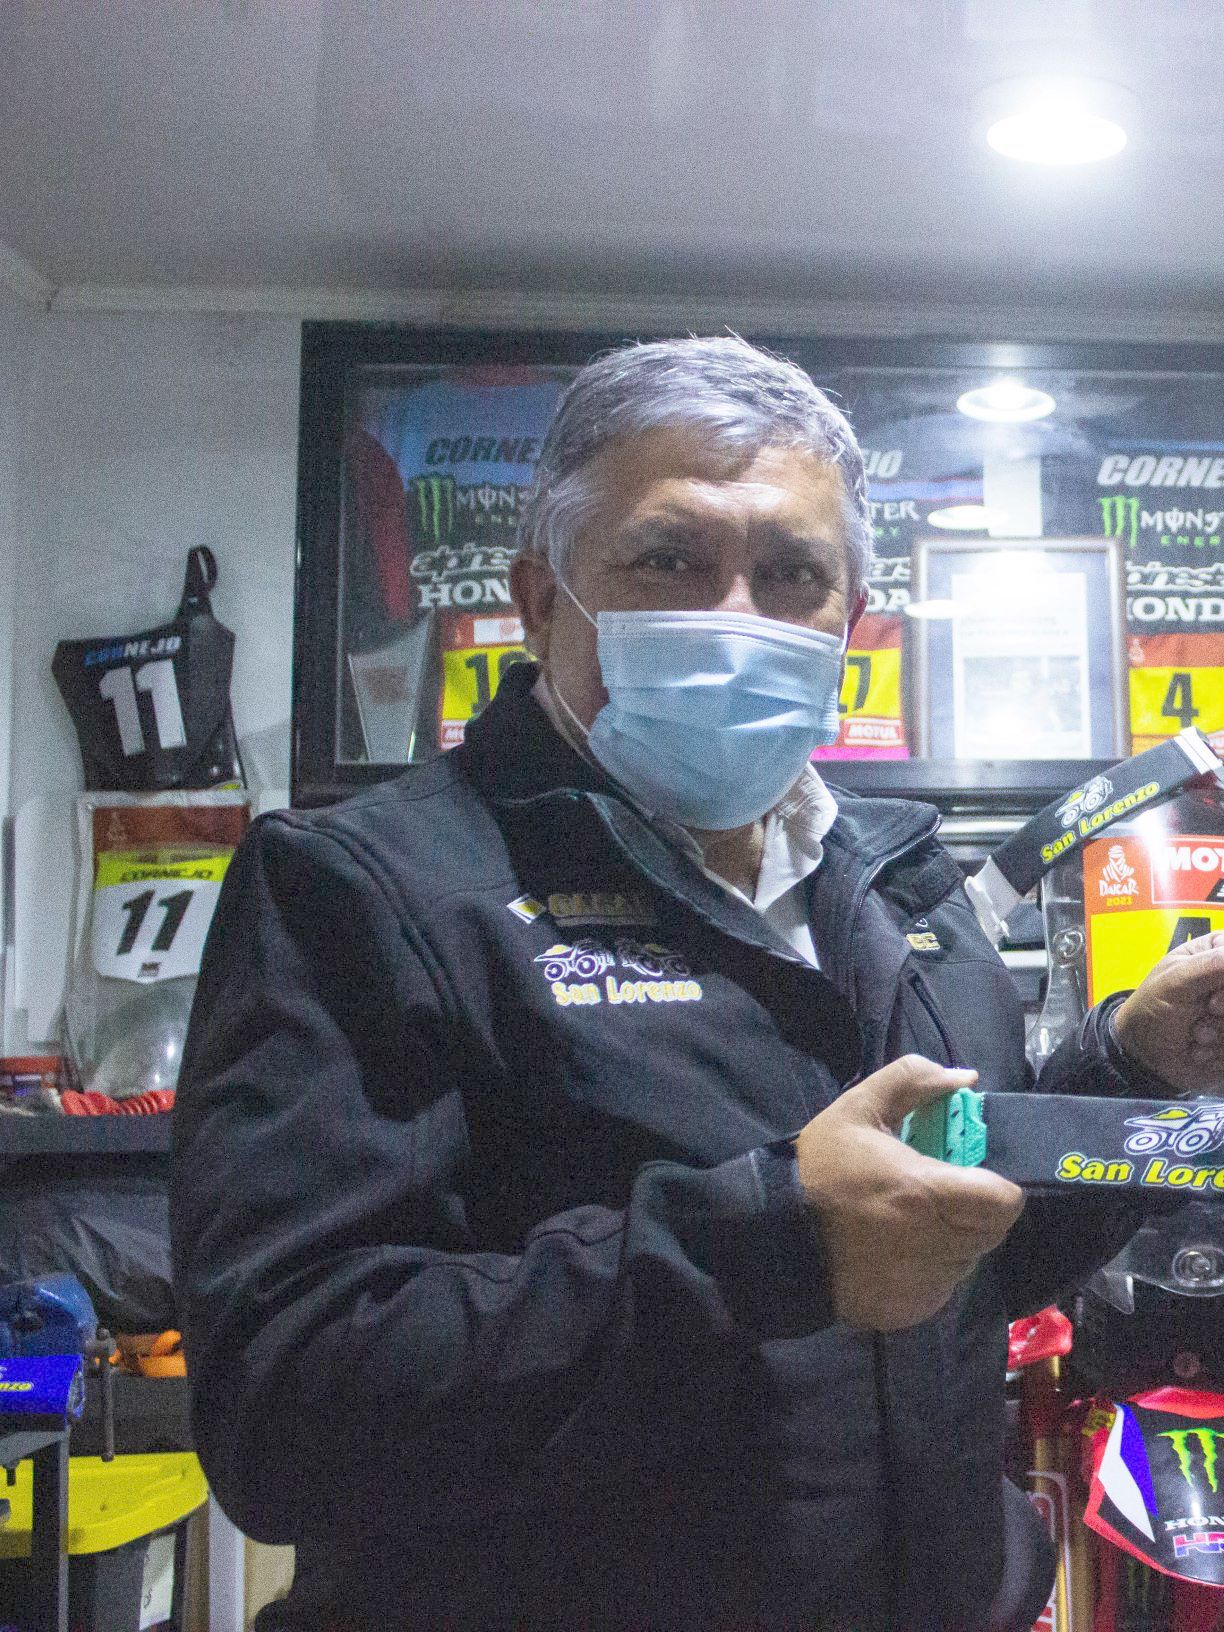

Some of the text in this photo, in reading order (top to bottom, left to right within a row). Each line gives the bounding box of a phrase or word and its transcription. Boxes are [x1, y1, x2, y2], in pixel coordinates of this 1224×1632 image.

[425, 437, 541, 465] CORNE
[418, 579, 513, 608] HON
[839, 656, 872, 714] 7
[1162, 673, 1199, 728] 4
[99, 658, 188, 757] 11
[1040, 781, 1161, 864] San Lorenzo
[1099, 878, 1140, 898] DAKAR
[116, 889, 195, 956] 11
[551, 975, 703, 1007] San Lorenzo
[1056, 1152, 1134, 1184] San
